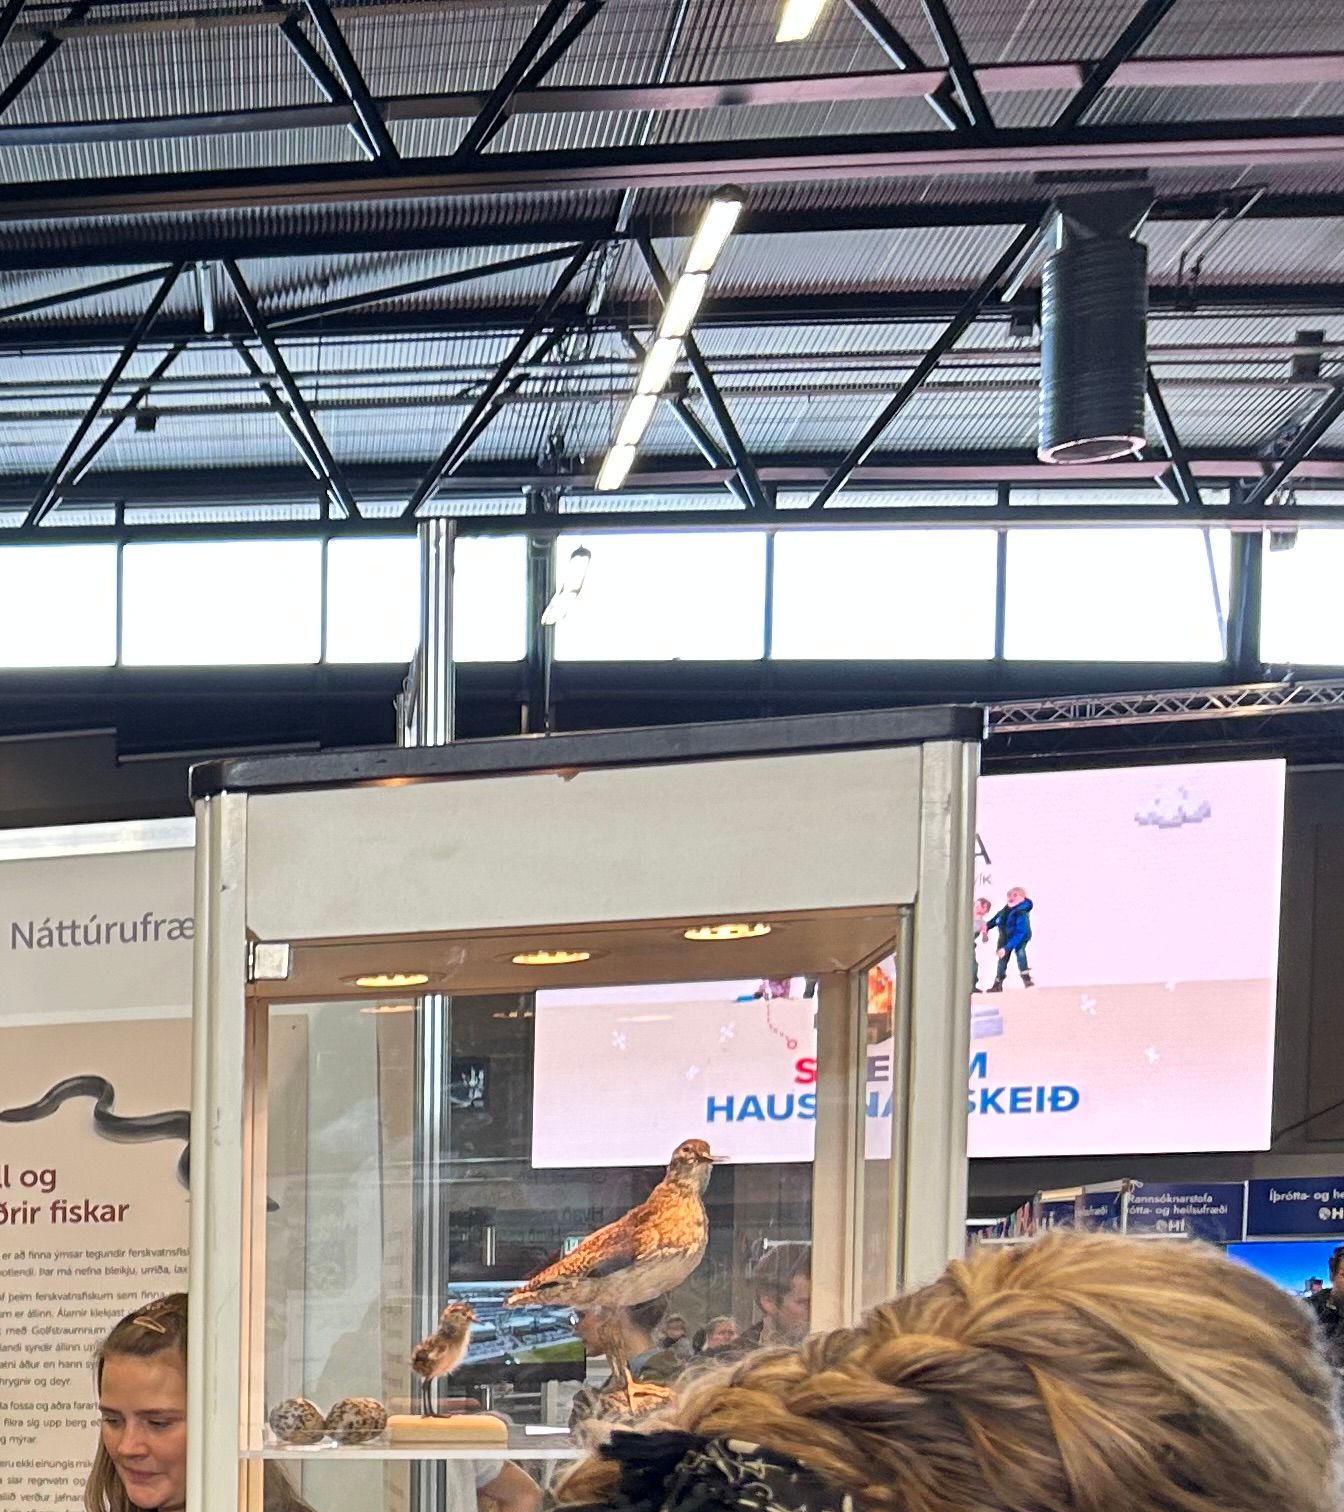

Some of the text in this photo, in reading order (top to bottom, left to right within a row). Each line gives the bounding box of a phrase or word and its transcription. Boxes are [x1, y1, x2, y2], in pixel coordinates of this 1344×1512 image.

[10, 911, 194, 950] Náttúrufræ
[20, 1169, 56, 1193] og
[1313, 1191, 1329, 1202] og
[50, 1199, 129, 1224] fiskar
[1155, 1206, 1170, 1216] og
[14, 1250, 26, 1260] að
[6, 1326, 27, 1335] með
[34, 1378, 47, 1387] og
[36, 1402, 48, 1412] og
[65, 1418, 87, 1429] berg
[73, 1477, 84, 1487] og
